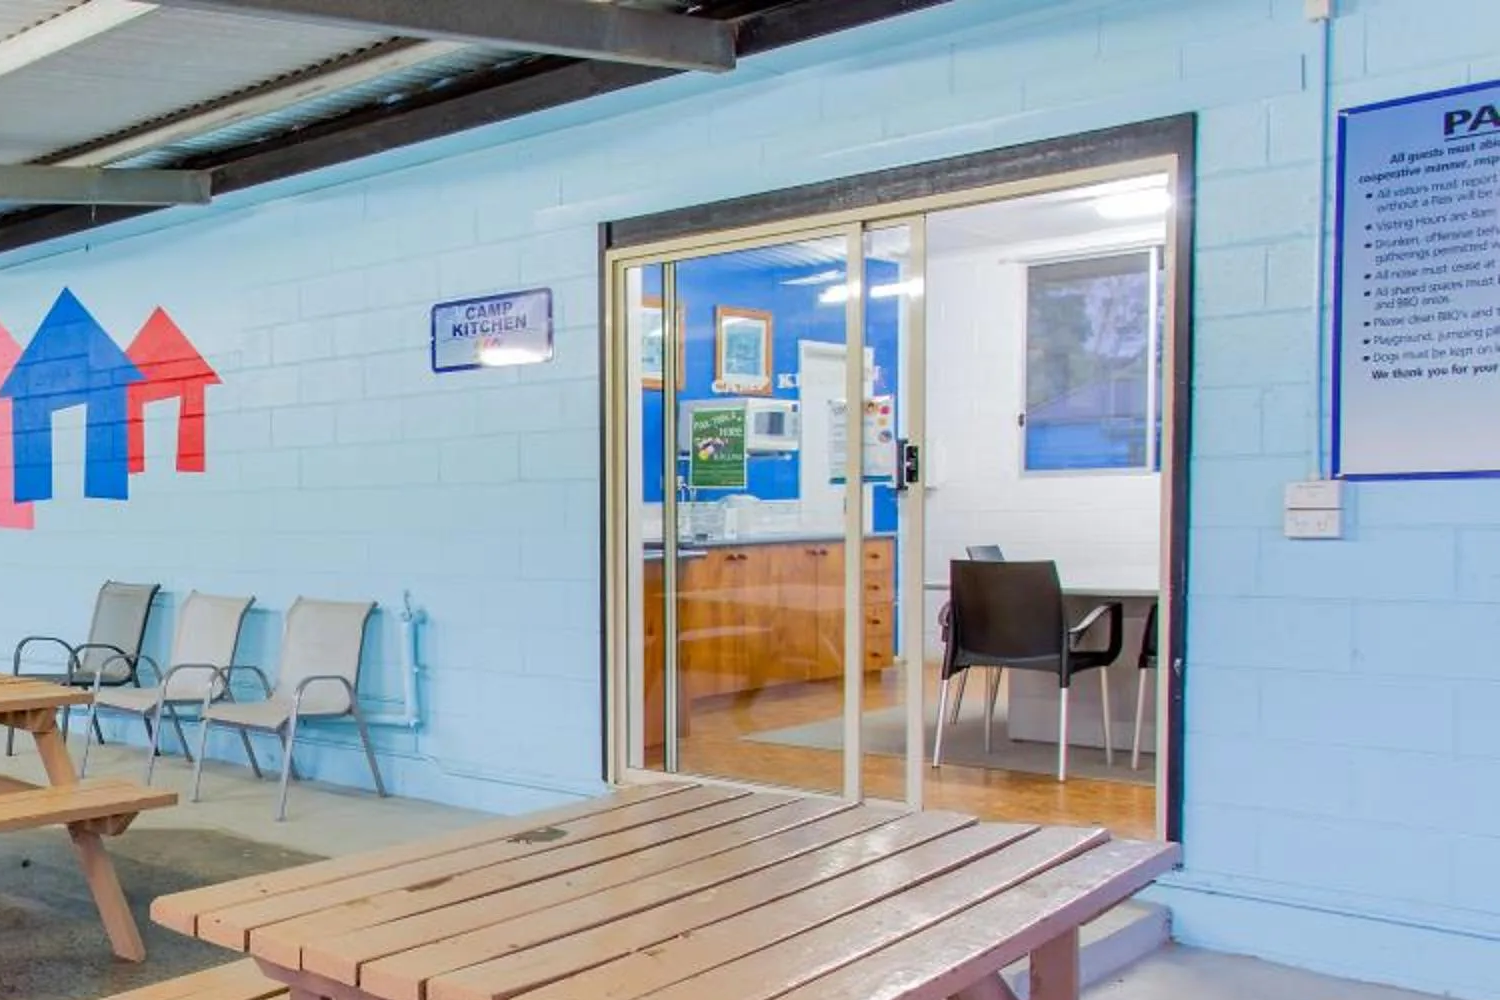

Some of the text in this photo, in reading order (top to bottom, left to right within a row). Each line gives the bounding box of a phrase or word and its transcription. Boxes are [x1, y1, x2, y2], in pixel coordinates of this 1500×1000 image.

[1389, 152, 1405, 164] All
[1407, 147, 1444, 163] guests
[1447, 143, 1475, 156] must
[1358, 167, 1422, 184] cooperative
[1377, 173, 1497, 198] All visitors must report
[1377, 199, 1419, 213] without
[1421, 199, 1429, 207] a
[1457, 190, 1475, 202] will
[1477, 189, 1493, 199] be
[1375, 218, 1414, 231] Visiting
[1415, 214, 1447, 225] Hours
[1449, 211, 1469, 221] are
[1425, 230, 1473, 242] offensive
[1375, 248, 1430, 266] gatherings
[1432, 240, 1488, 257] permitted
[1375, 269, 1389, 280] All
[1391, 268, 1419, 279] noise
[1421, 263, 1447, 275] must
[1451, 261, 1481, 272] cease
[1375, 276, 1493, 297] All shared spaces must
[465, 301, 513, 320] CAMP
[1374, 298, 1395, 310] and
[1397, 295, 1419, 308] BBQ
[451, 313, 527, 337] KITCHEN
[1373, 317, 1405, 328] Please
[1407, 314, 1435, 326] clean
[1470, 306, 1493, 319] and
[1438, 328, 1483, 343] jumping
[1373, 344, 1493, 365] Dogs must be kept on
[1372, 363, 1498, 380] We thank you for your
